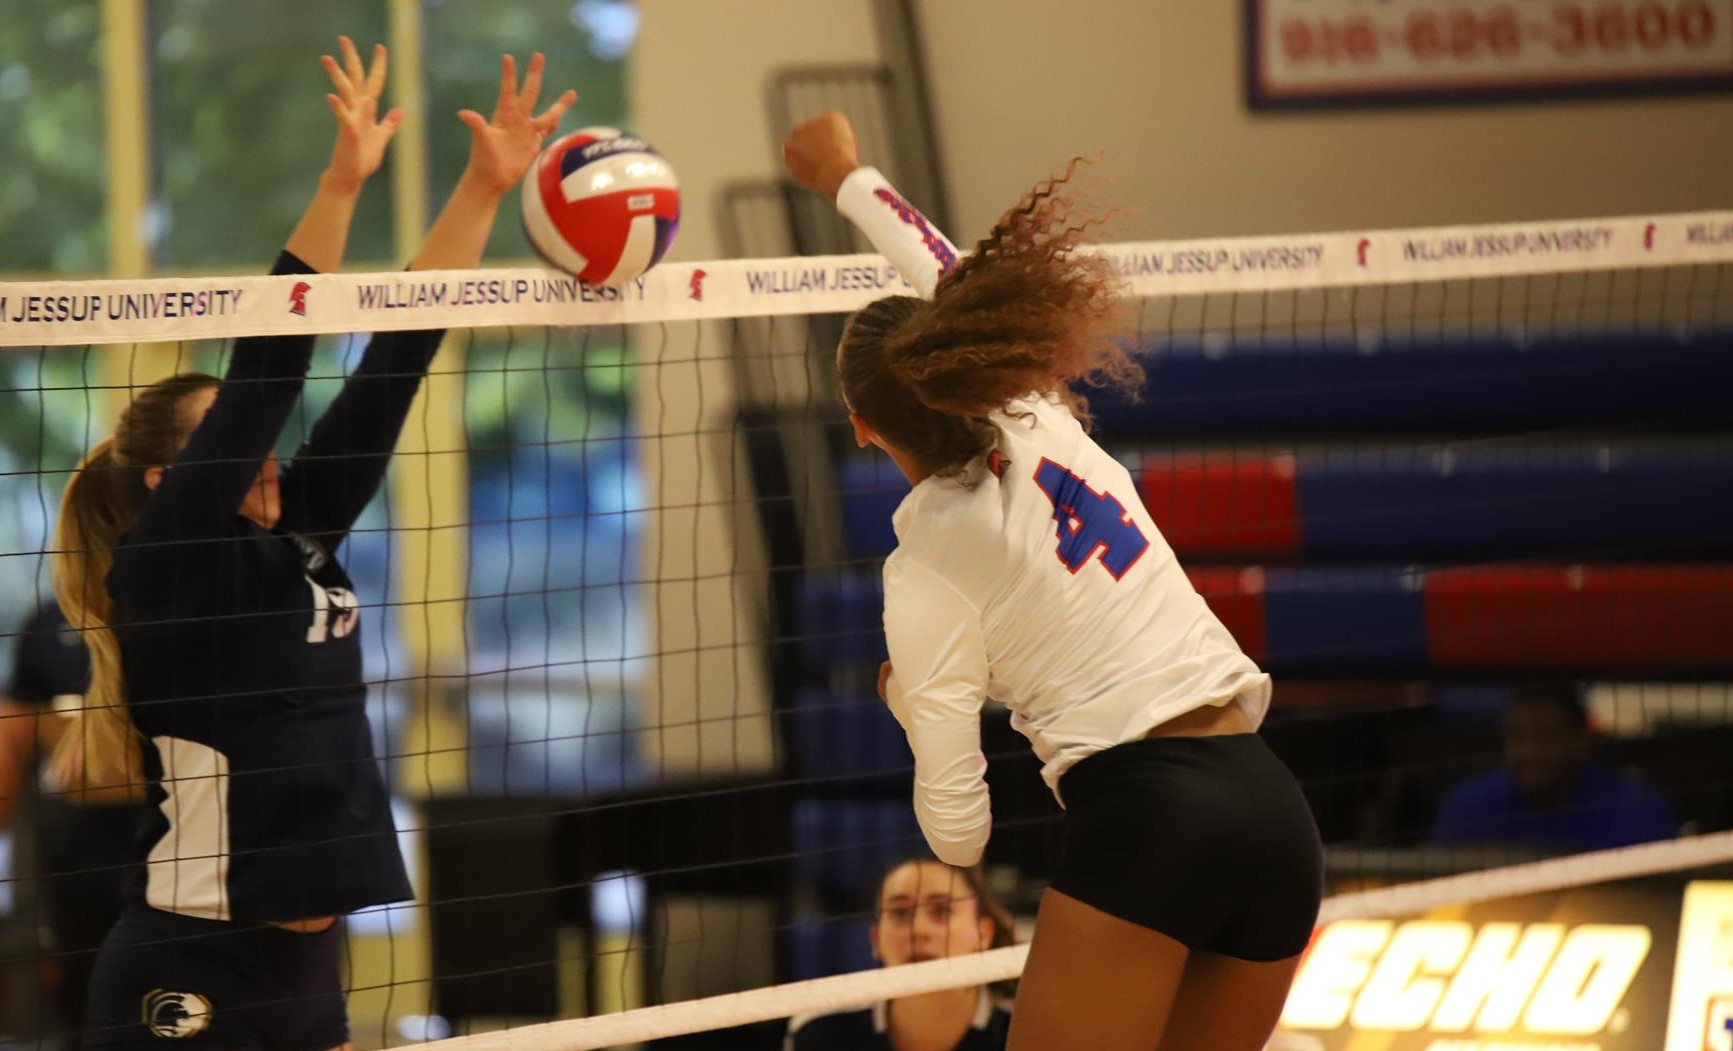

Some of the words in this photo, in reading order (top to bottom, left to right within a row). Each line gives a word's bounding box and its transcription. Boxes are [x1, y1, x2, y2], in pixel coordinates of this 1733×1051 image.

[1166, 250, 1228, 275] JESSUP
[1231, 245, 1323, 271] UNIVERSITY
[1402, 238, 1467, 262] WILLIAM
[357, 282, 448, 309] WILLIAM
[451, 279, 528, 305] JESSUP
[533, 277, 646, 303] UNIVERSIY
[746, 270, 825, 294] WILLIAM
[829, 265, 897, 291] JESSUP
[12, 296, 101, 323] JESSUP
[108, 289, 244, 321] UNIVERSITY
[1033, 456, 1150, 583] 4
[1280, 919, 1652, 1036] ECHO
